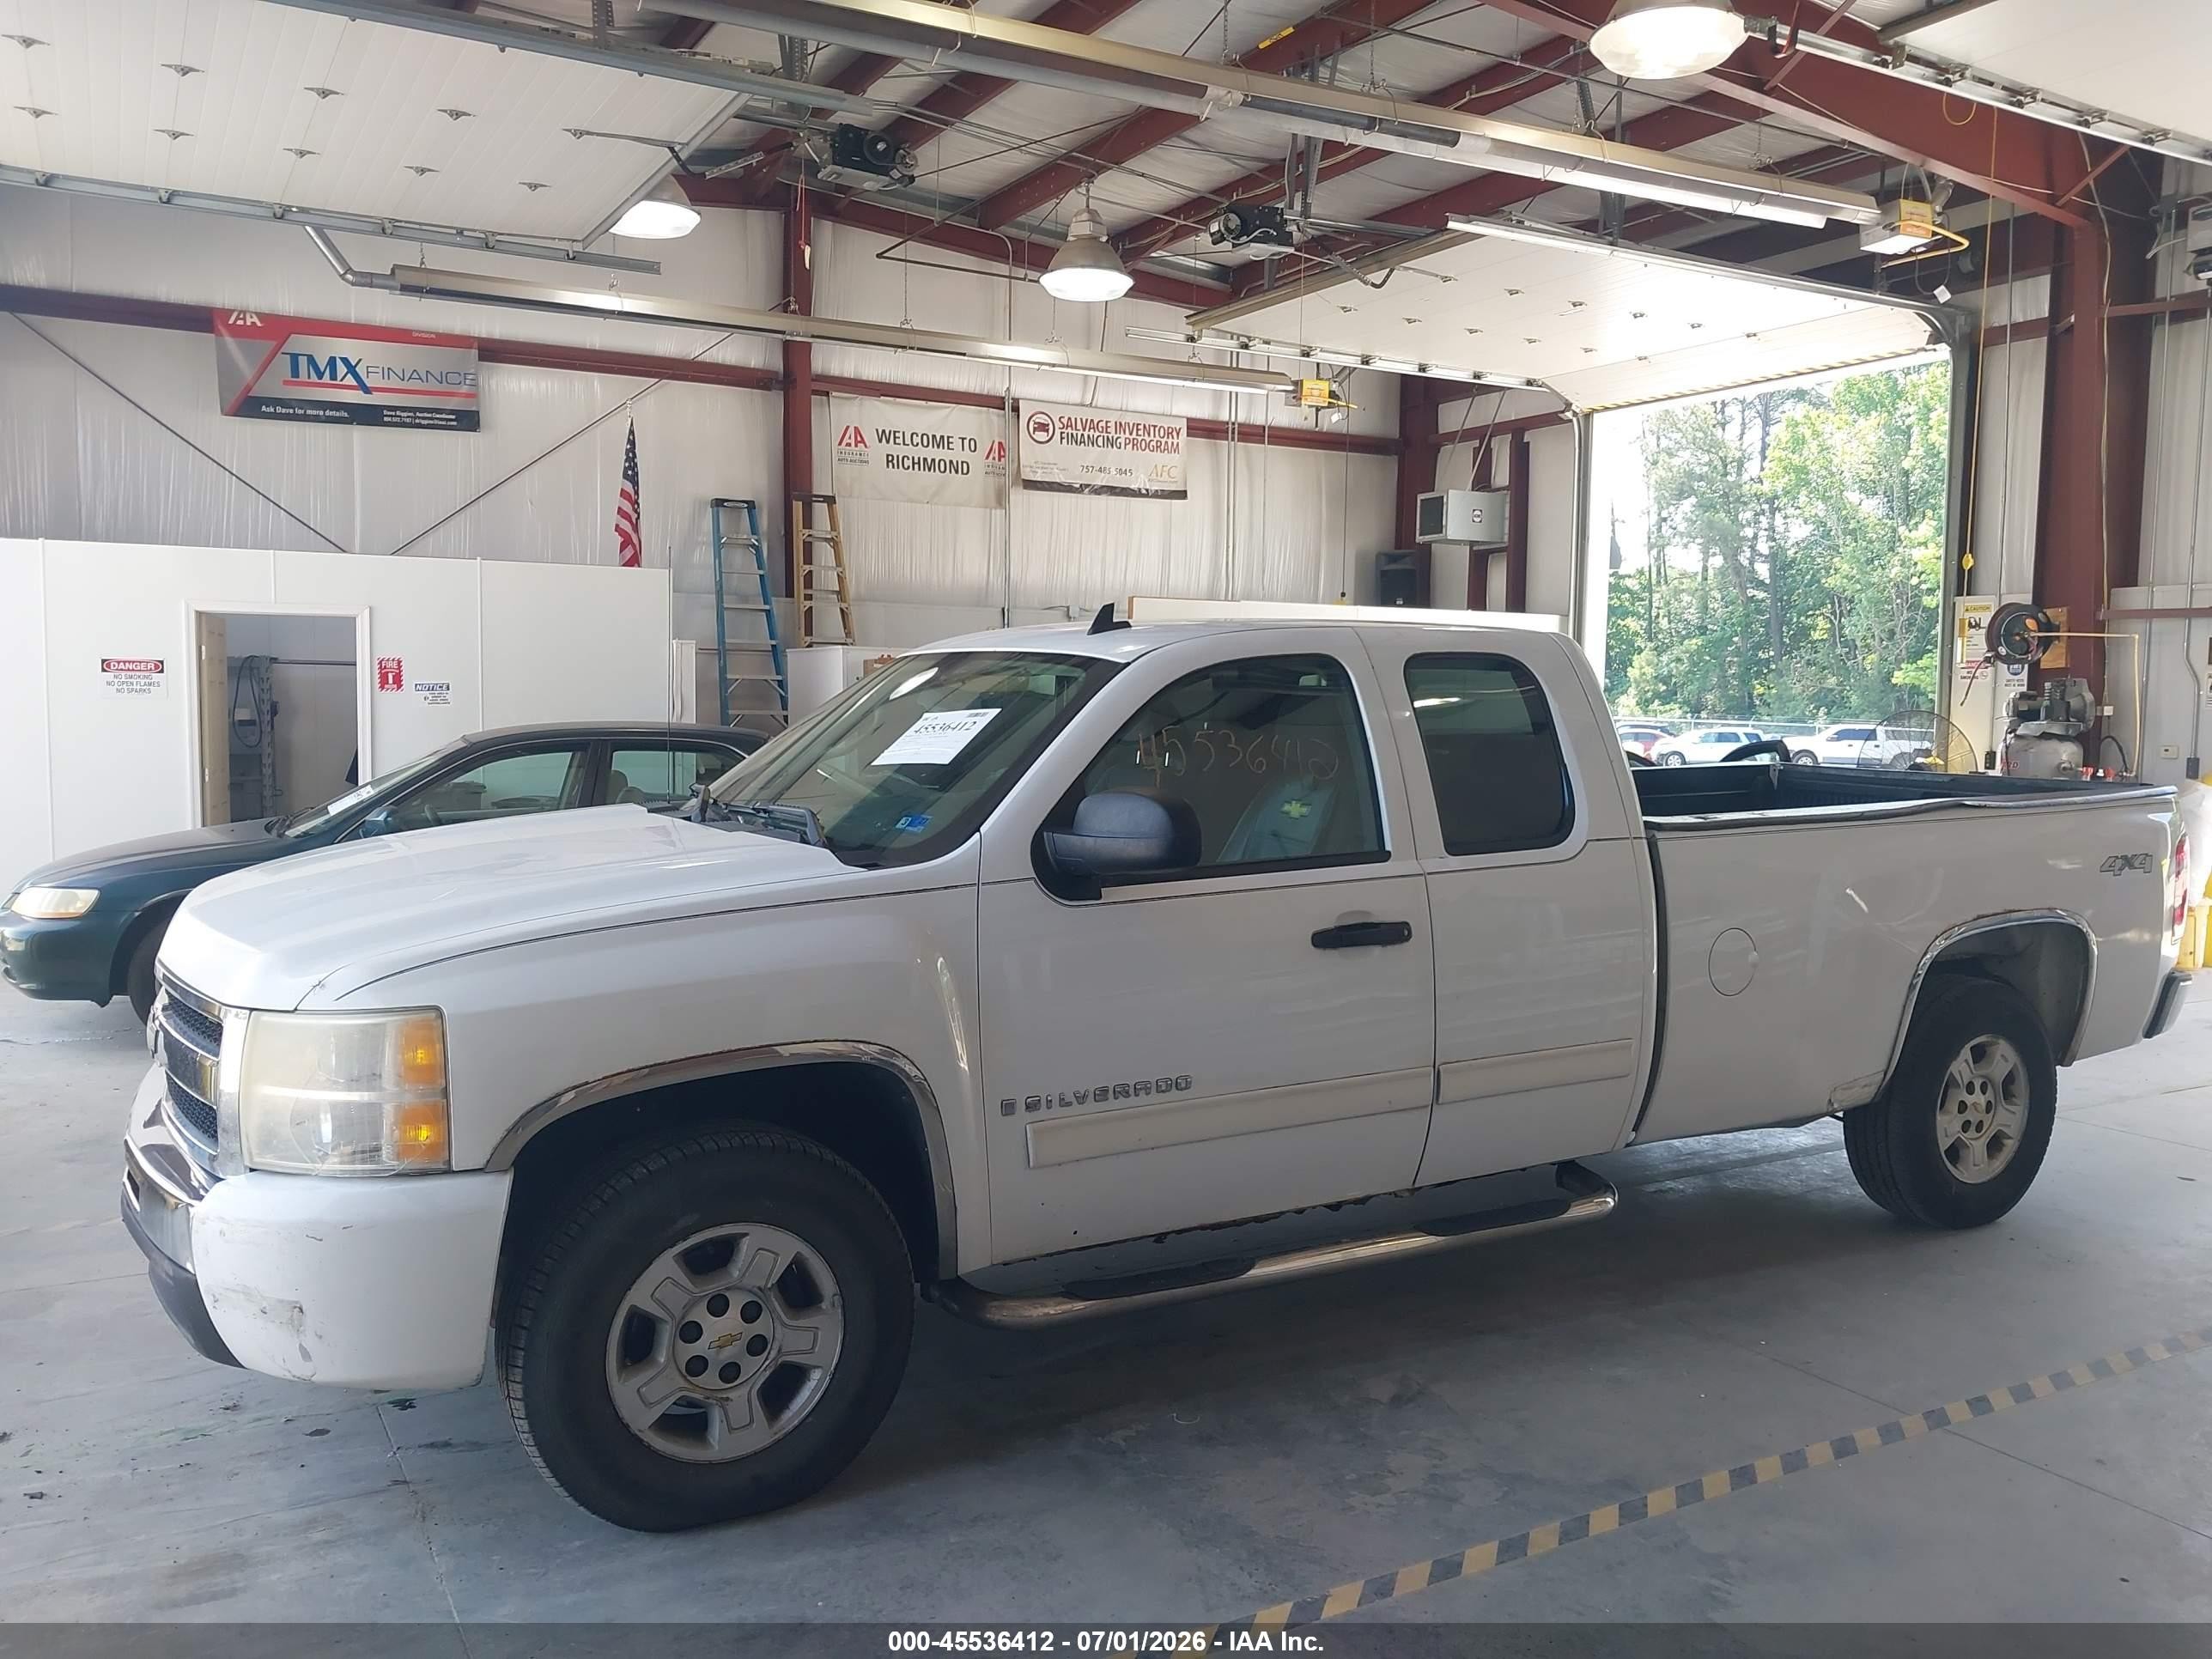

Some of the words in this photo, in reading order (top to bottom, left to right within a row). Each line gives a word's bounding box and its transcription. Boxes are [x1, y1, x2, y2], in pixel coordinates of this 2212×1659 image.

[282, 352, 373, 395] TMX
[366, 365, 478, 386] FINANCE
[1058, 416, 1111, 434] SALVAGE
[1115, 421, 1182, 440] INVENTORY
[875, 428, 955, 451] WELCOME
[958, 436, 977, 453] TO
[1060, 431, 1121, 450] FINANCING
[1124, 437, 1180, 454] PROGRAM
[885, 453, 970, 476] RICHMOND
[1149, 464, 1177, 479] AFC
[110, 661, 155, 671] DANGER
[381, 660, 398, 669] FIRE
[416, 683, 448, 691] NOTICE
[1025, 1074, 1193, 1113] SILVERADO
